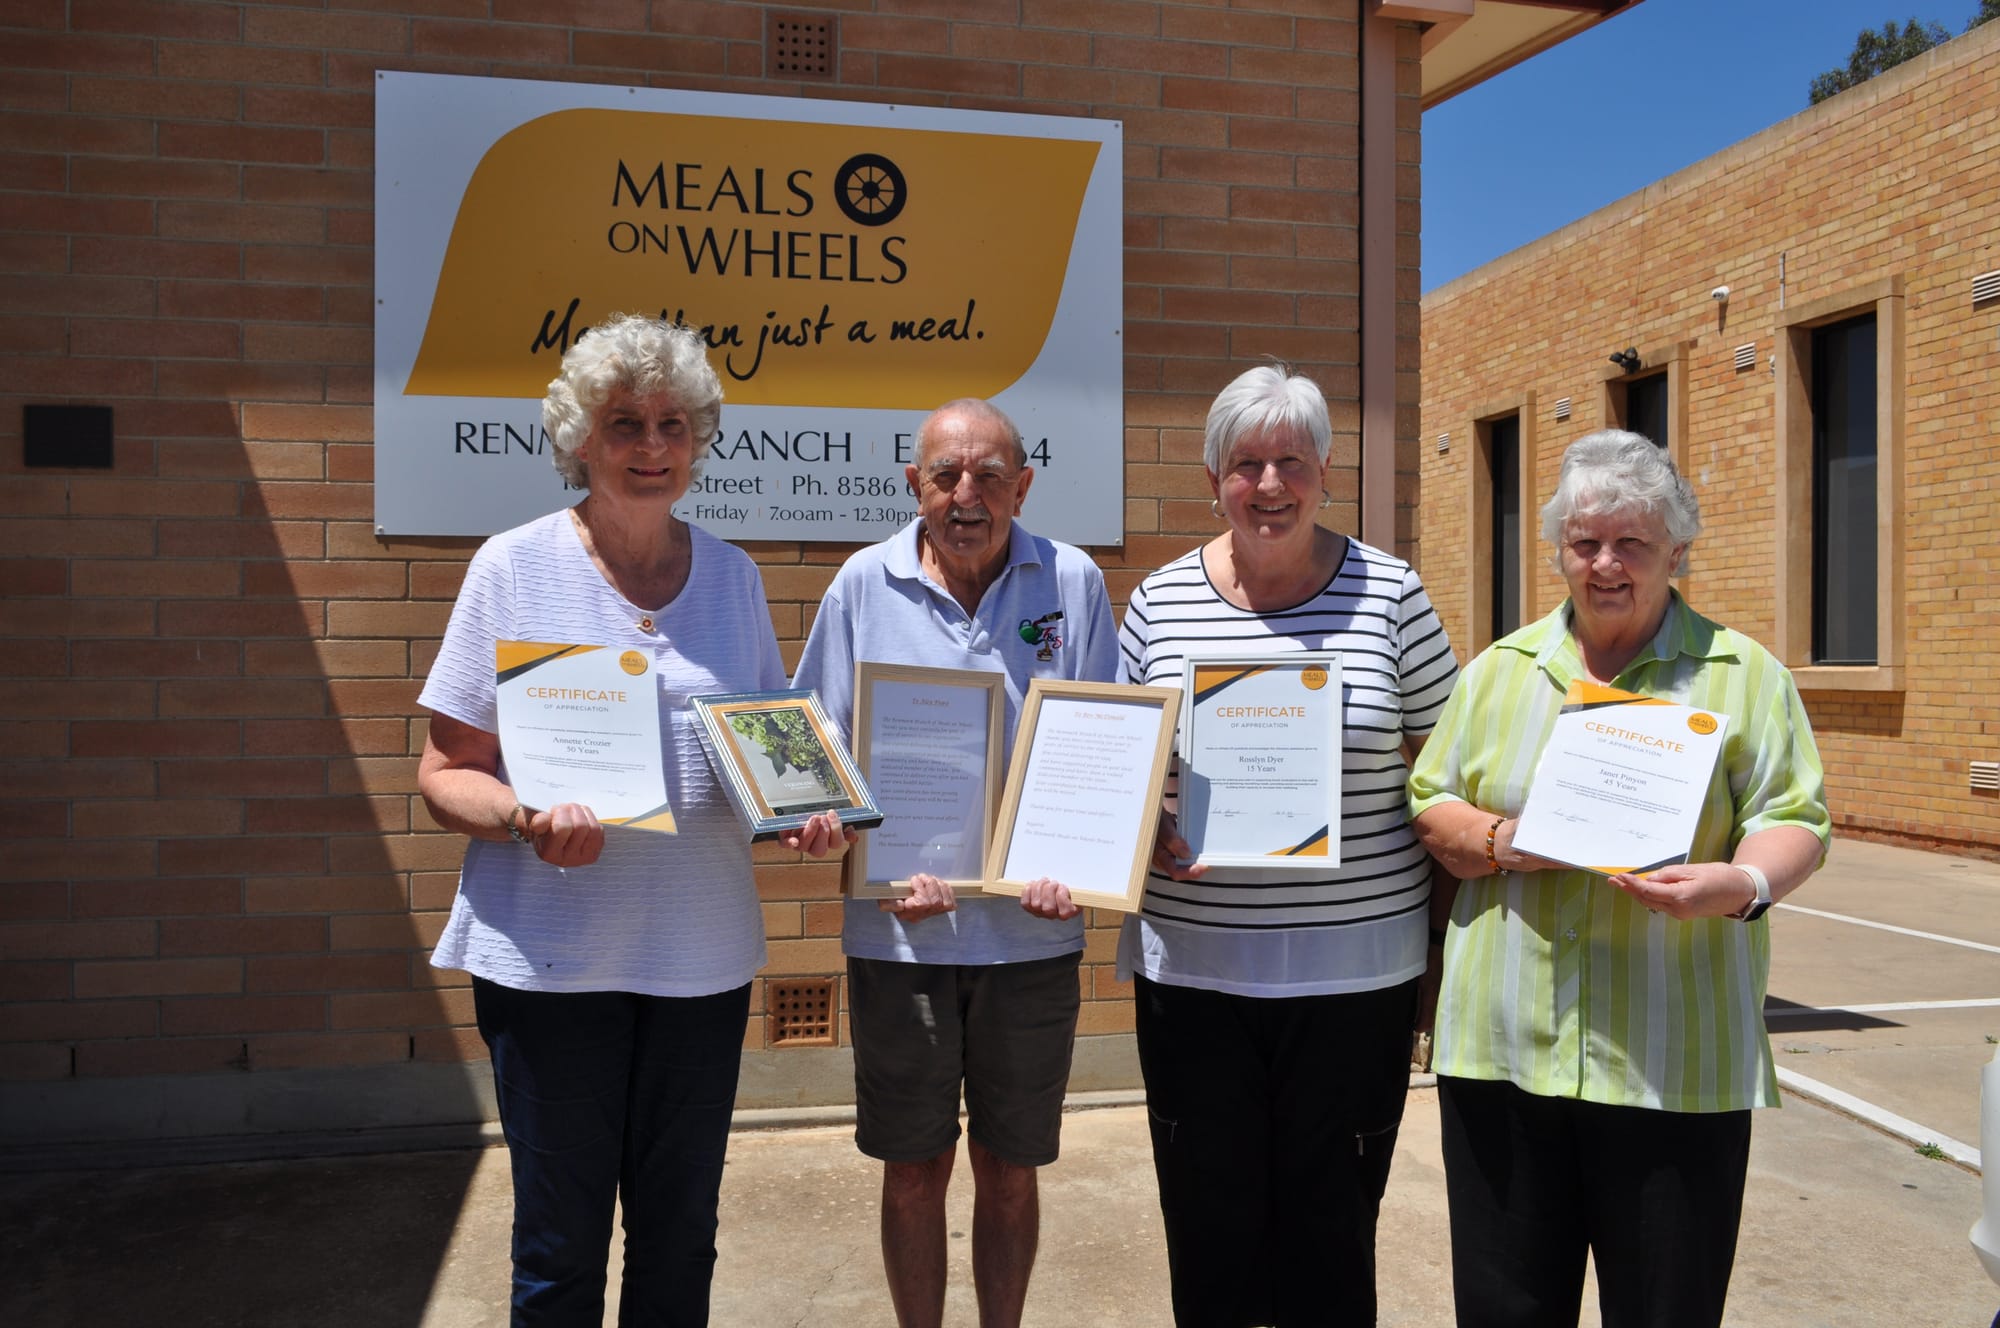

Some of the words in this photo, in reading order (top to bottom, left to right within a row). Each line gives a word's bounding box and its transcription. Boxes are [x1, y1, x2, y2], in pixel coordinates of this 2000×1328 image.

[611, 158, 815, 217] MEALS
[607, 221, 669, 255] ON
[676, 225, 908, 285] WHEELS
[726, 304, 836, 381] just
[847, 320, 877, 344] a
[889, 298, 985, 342] meal.
[709, 429, 852, 463] RANCH
[690, 474, 765, 495] Street
[792, 474, 828, 496] Ph.
[837, 475, 897, 497] 8586
[696, 503, 750, 525] Friday
[526, 687, 627, 702] CERTIFICATE
[556, 704, 609, 712] APPRECIATION
[1216, 706, 1306, 717] CERTIFICATE
[1585, 721, 1685, 753] CERTIFICATE
[579, 746, 600, 755] Years
[1247, 765, 1256, 773] 15
[1266, 756, 1284, 765] Dyer
[1615, 780, 1638, 792] Years
